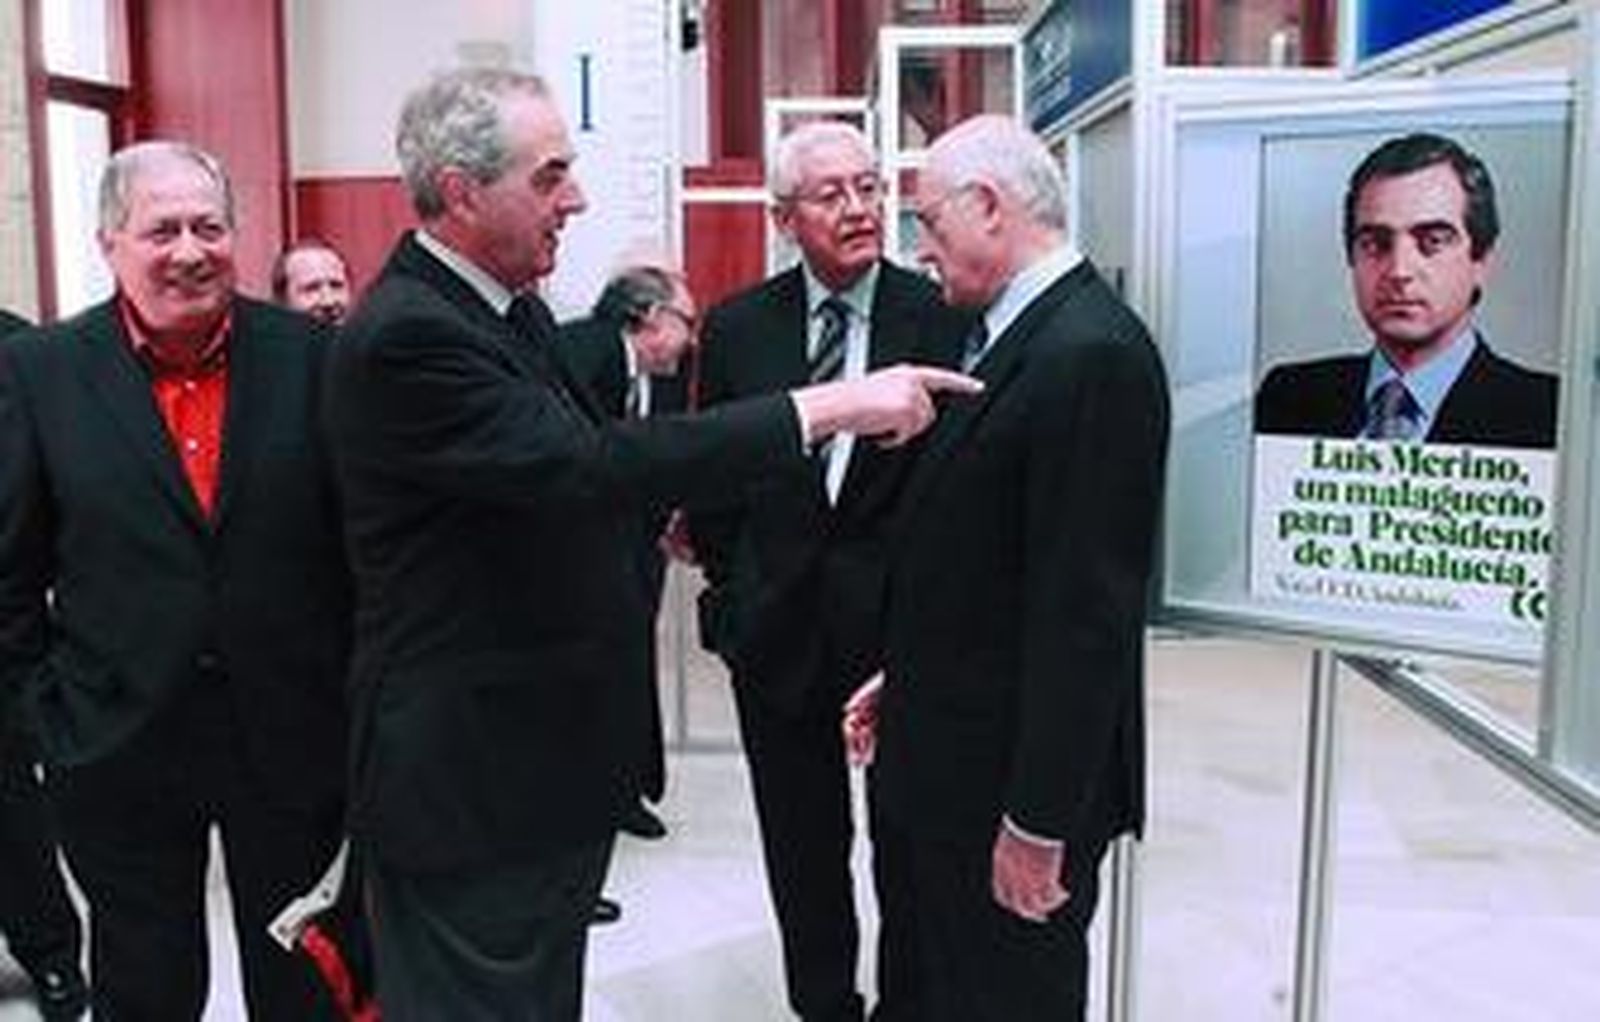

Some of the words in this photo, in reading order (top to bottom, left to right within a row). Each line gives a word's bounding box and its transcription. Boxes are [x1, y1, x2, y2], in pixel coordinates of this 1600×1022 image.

[1310, 438, 1382, 472] Luis
[1389, 445, 1530, 485] Merino,
[1293, 477, 1339, 503] un
[1344, 479, 1544, 519] malagueño
[1278, 510, 1353, 540] para
[1293, 538, 1334, 569] de
